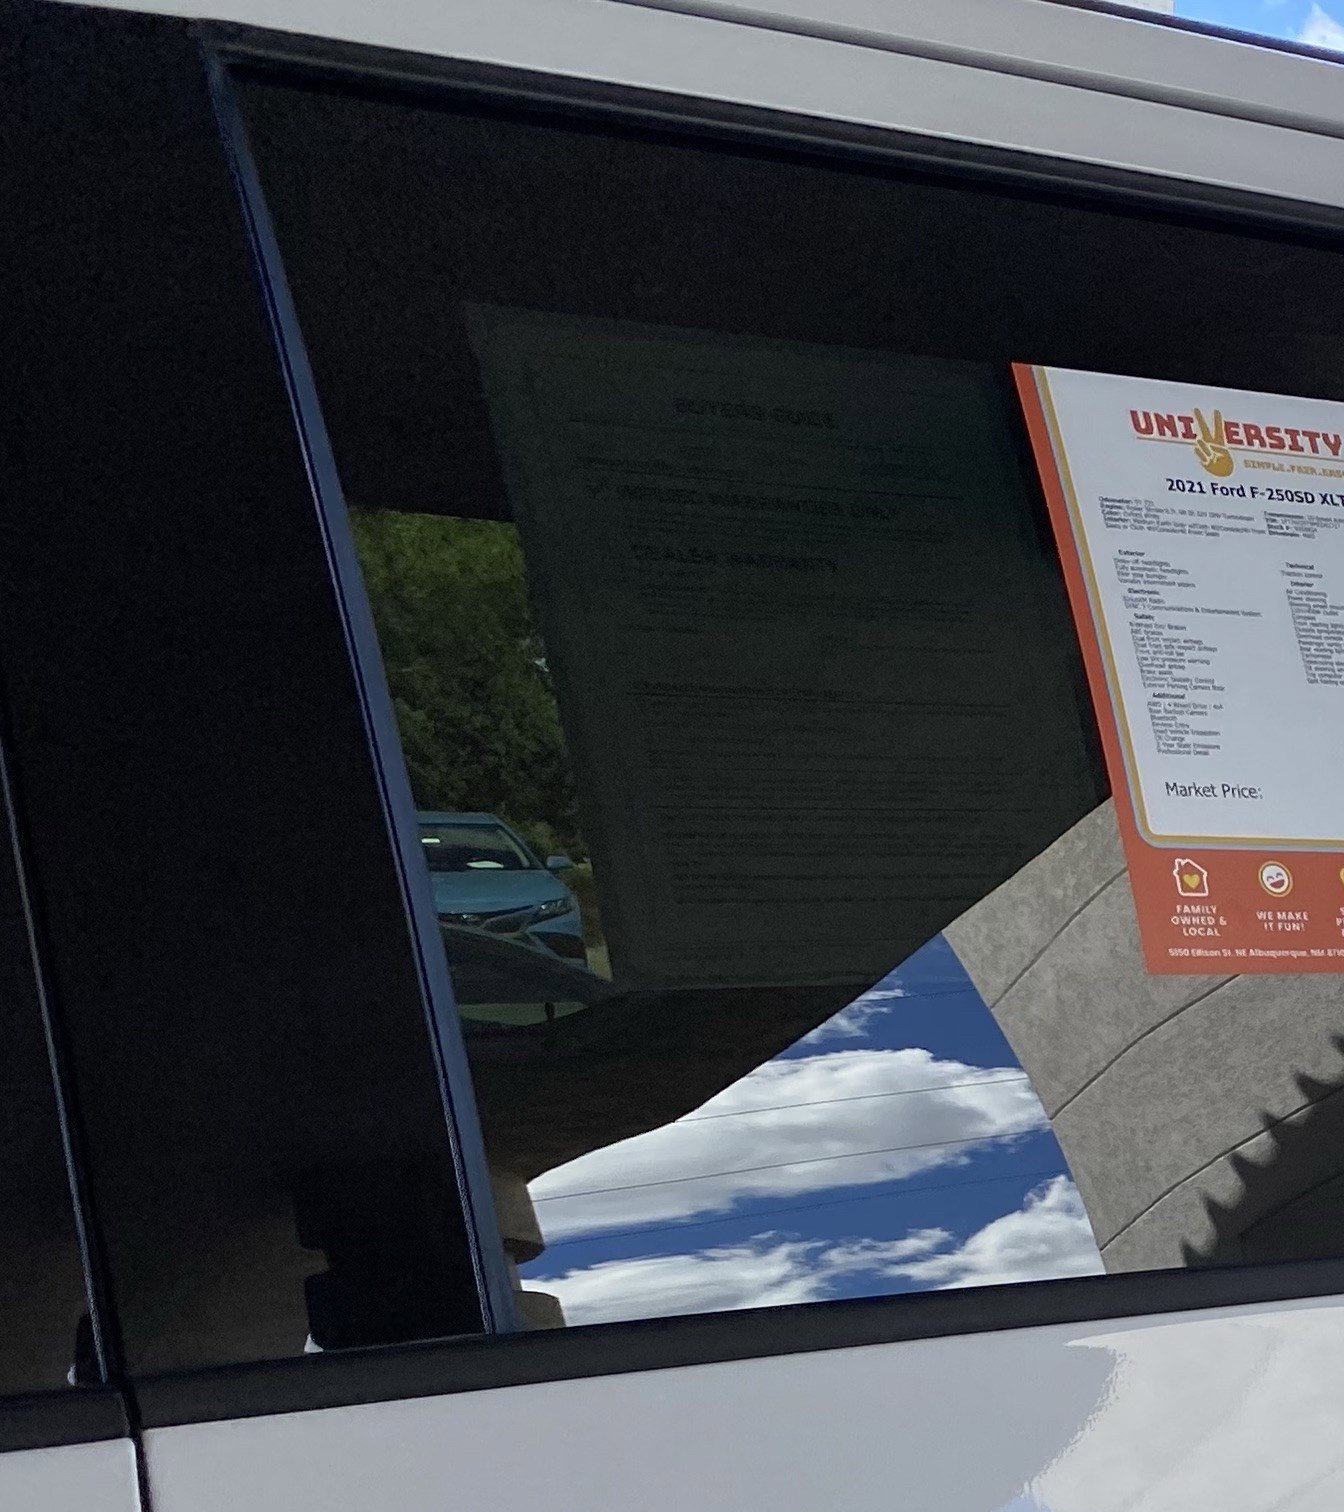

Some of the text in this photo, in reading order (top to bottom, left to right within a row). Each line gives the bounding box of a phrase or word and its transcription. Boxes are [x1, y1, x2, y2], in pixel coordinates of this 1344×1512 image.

[1130, 408, 1343, 457] UNIVERSITY
[1166, 478, 1206, 494] 2021
[1211, 482, 1246, 498] Ford
[1250, 486, 1316, 505] F-250SD
[1165, 781, 1217, 799] Market
[1221, 783, 1264, 800] Price:
[1176, 905, 1217, 914] FAMILY
[1171, 916, 1227, 925] OWNED &
[1256, 911, 1309, 921] WE MAKE
[1264, 922, 1305, 931] IT FUN!
[1183, 927, 1221, 937] LOCAL
